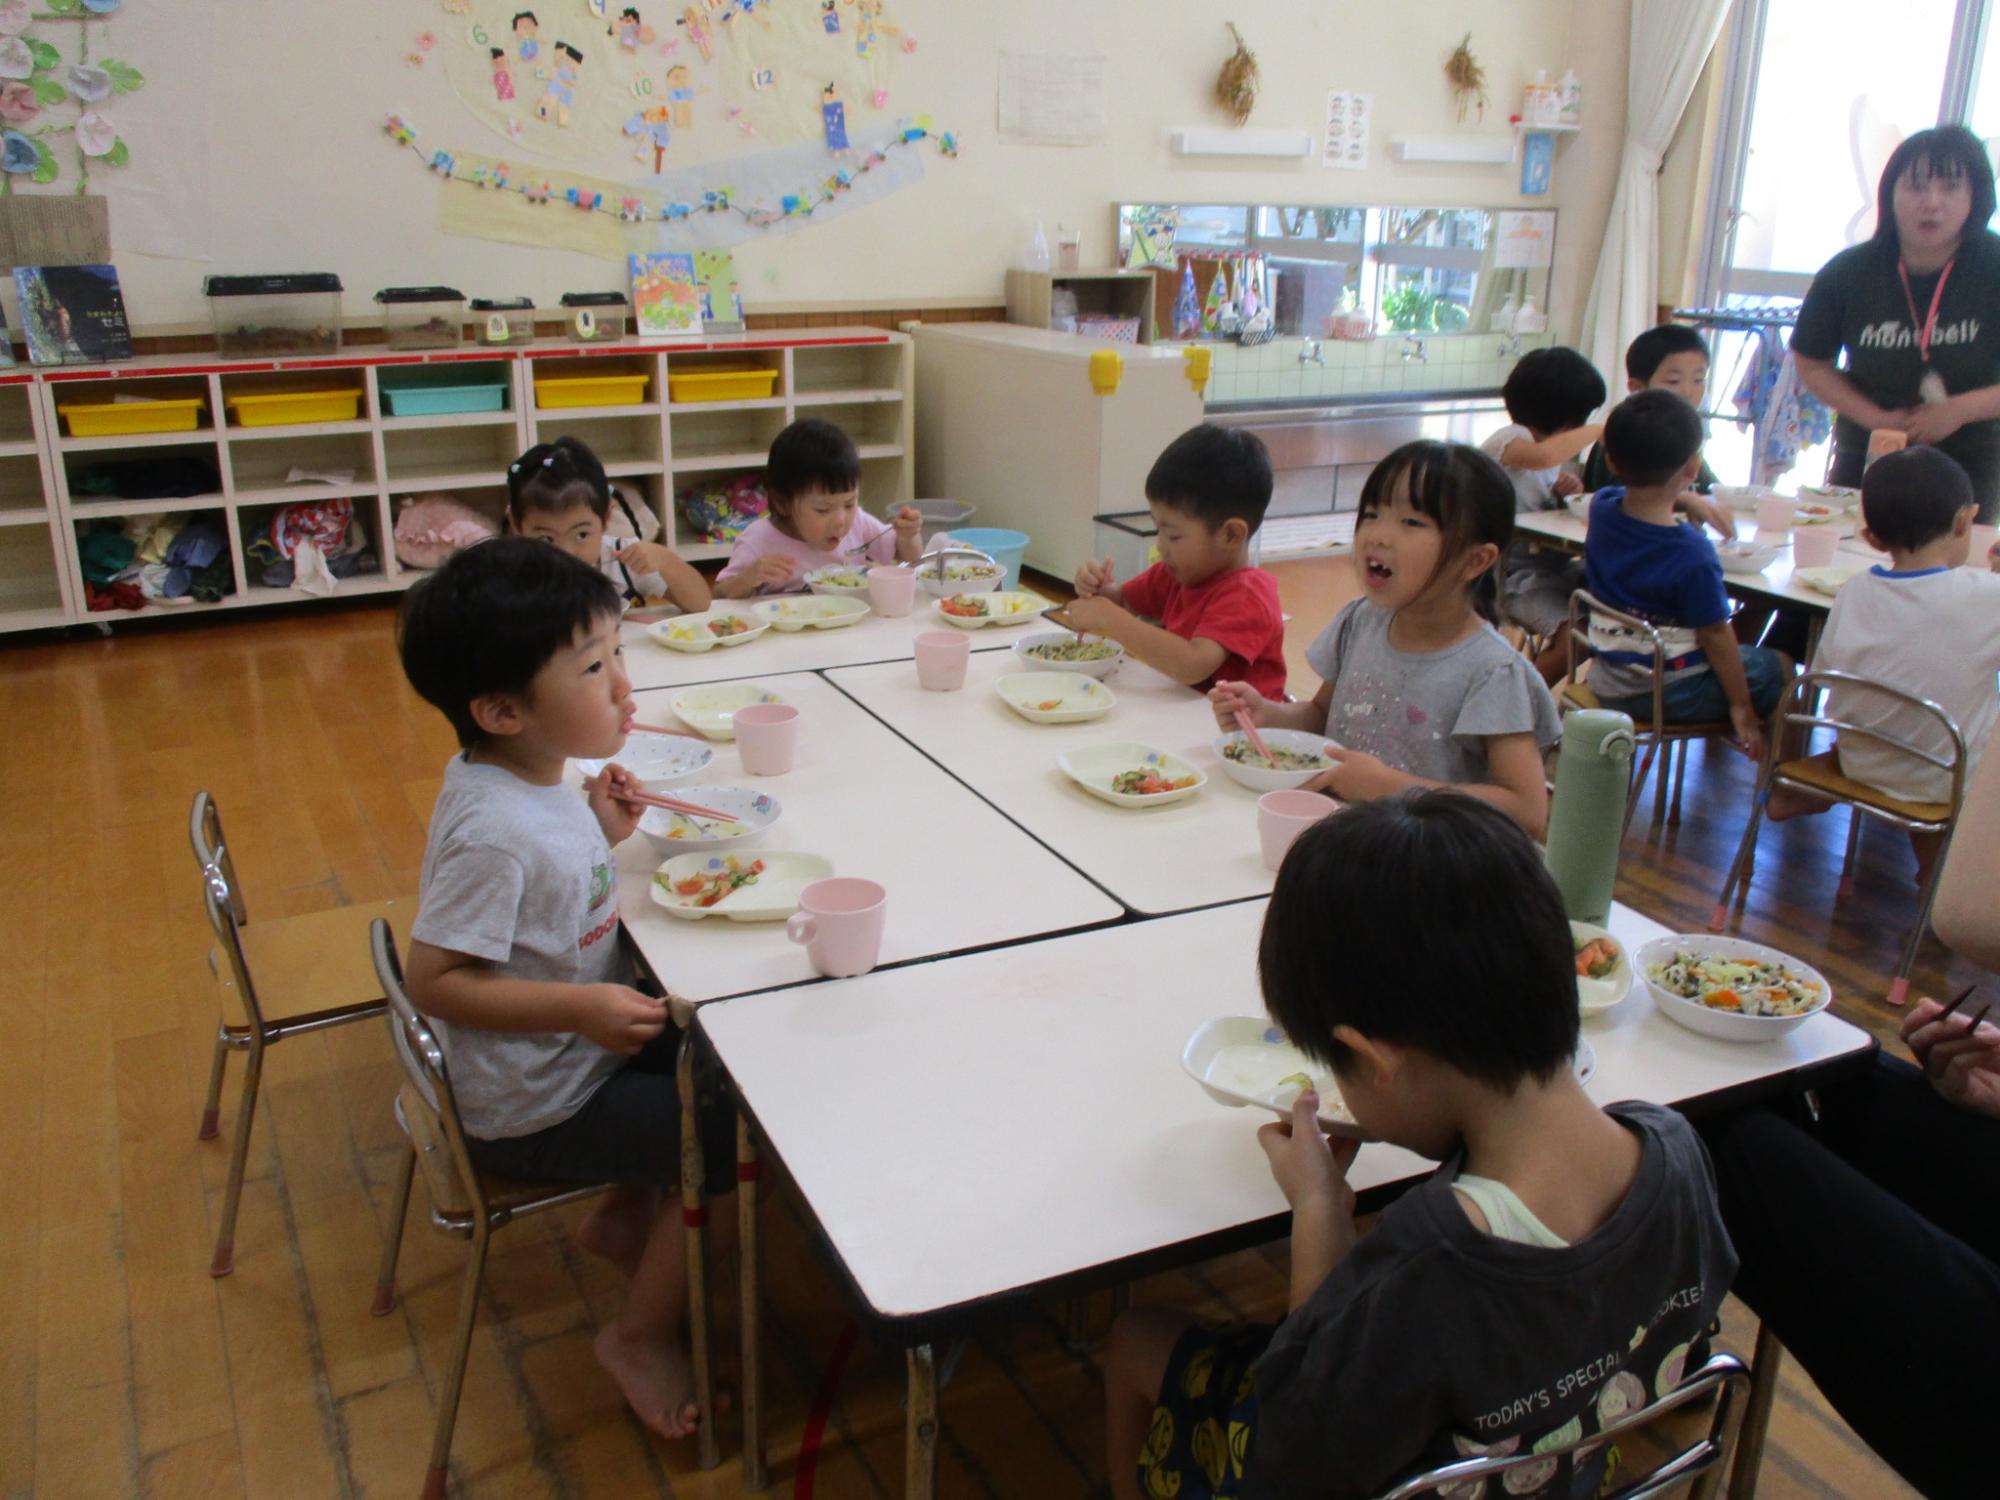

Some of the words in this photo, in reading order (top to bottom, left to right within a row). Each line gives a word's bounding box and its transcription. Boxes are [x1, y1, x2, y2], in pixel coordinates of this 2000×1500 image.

[472, 24, 489, 45] 6
[635, 78, 652, 96] 10
[757, 69, 773, 86] 12
[1475, 1389, 1550, 1429] TODAY'S
